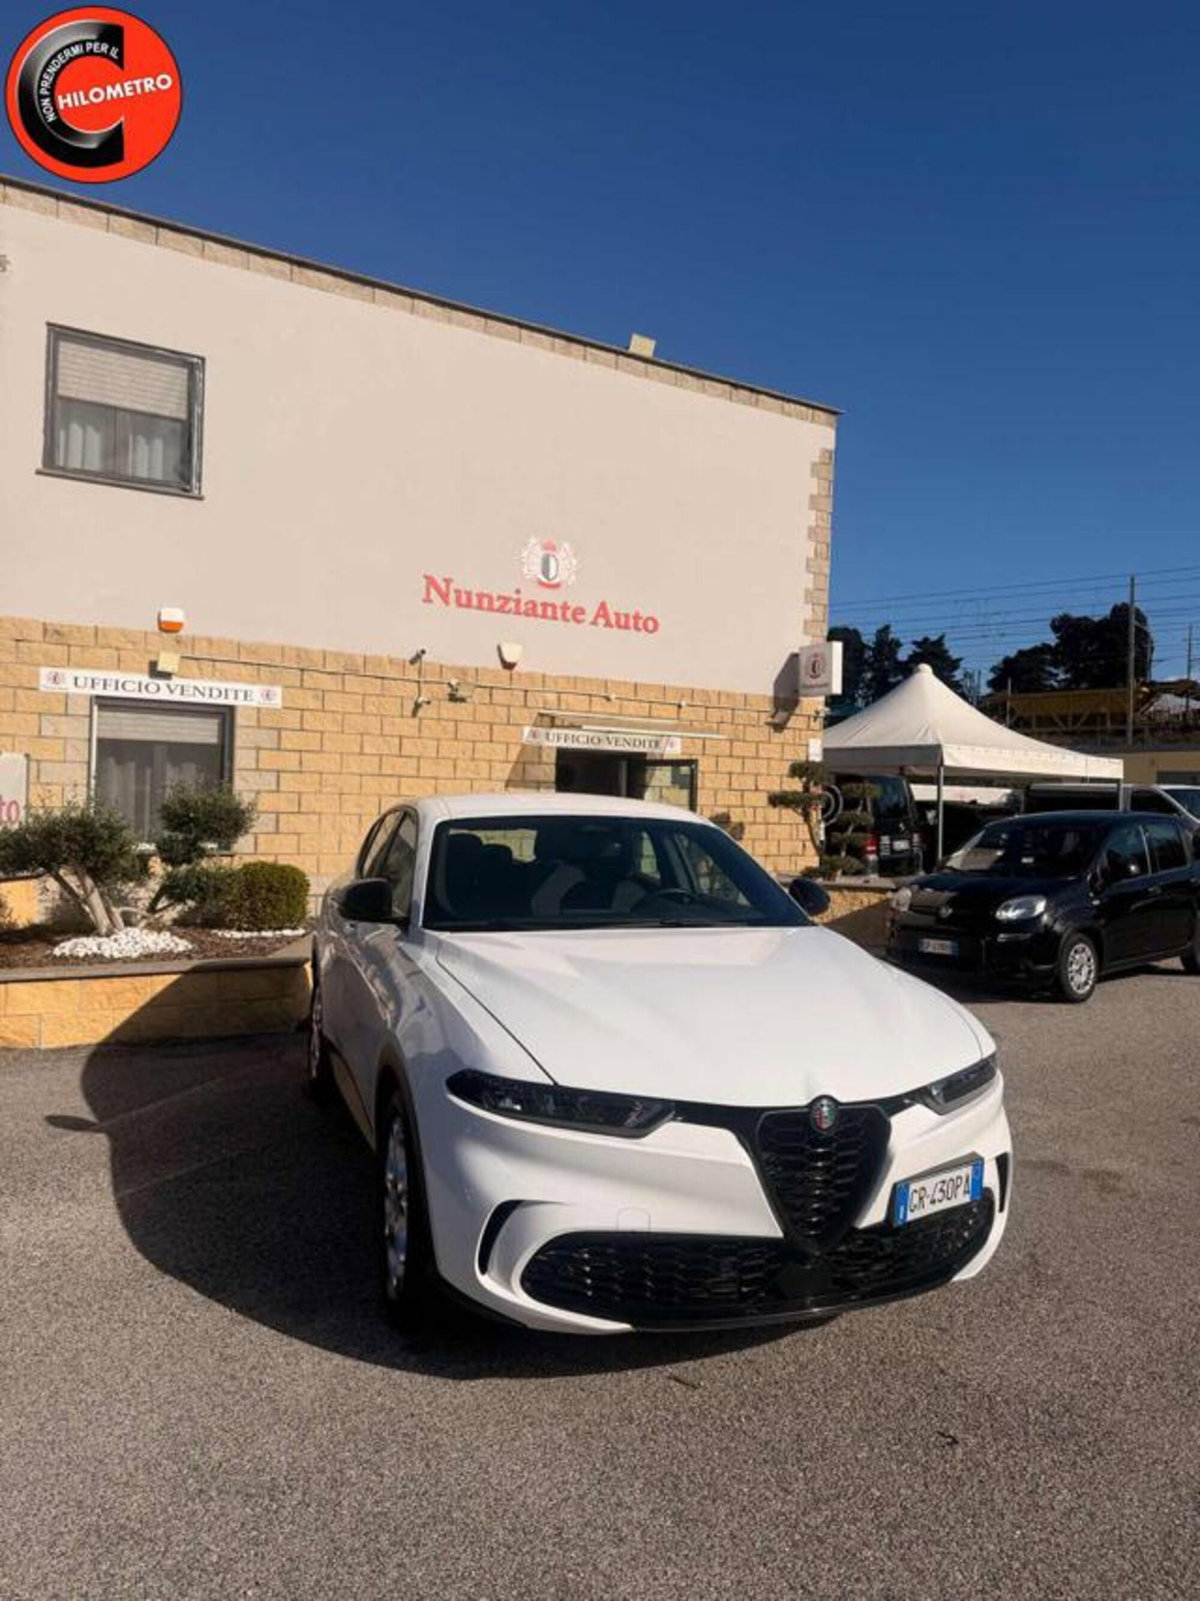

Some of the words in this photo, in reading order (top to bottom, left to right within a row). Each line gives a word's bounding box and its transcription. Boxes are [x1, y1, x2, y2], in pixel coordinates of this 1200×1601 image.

[422, 573, 586, 626] Nunziante
[589, 600, 660, 634] Auto
[74, 676, 161, 694] UFFICIO
[166, 683, 254, 702] VENDITE
[545, 731, 601, 746] UFFICIO
[605, 735, 661, 749] VENDITE
